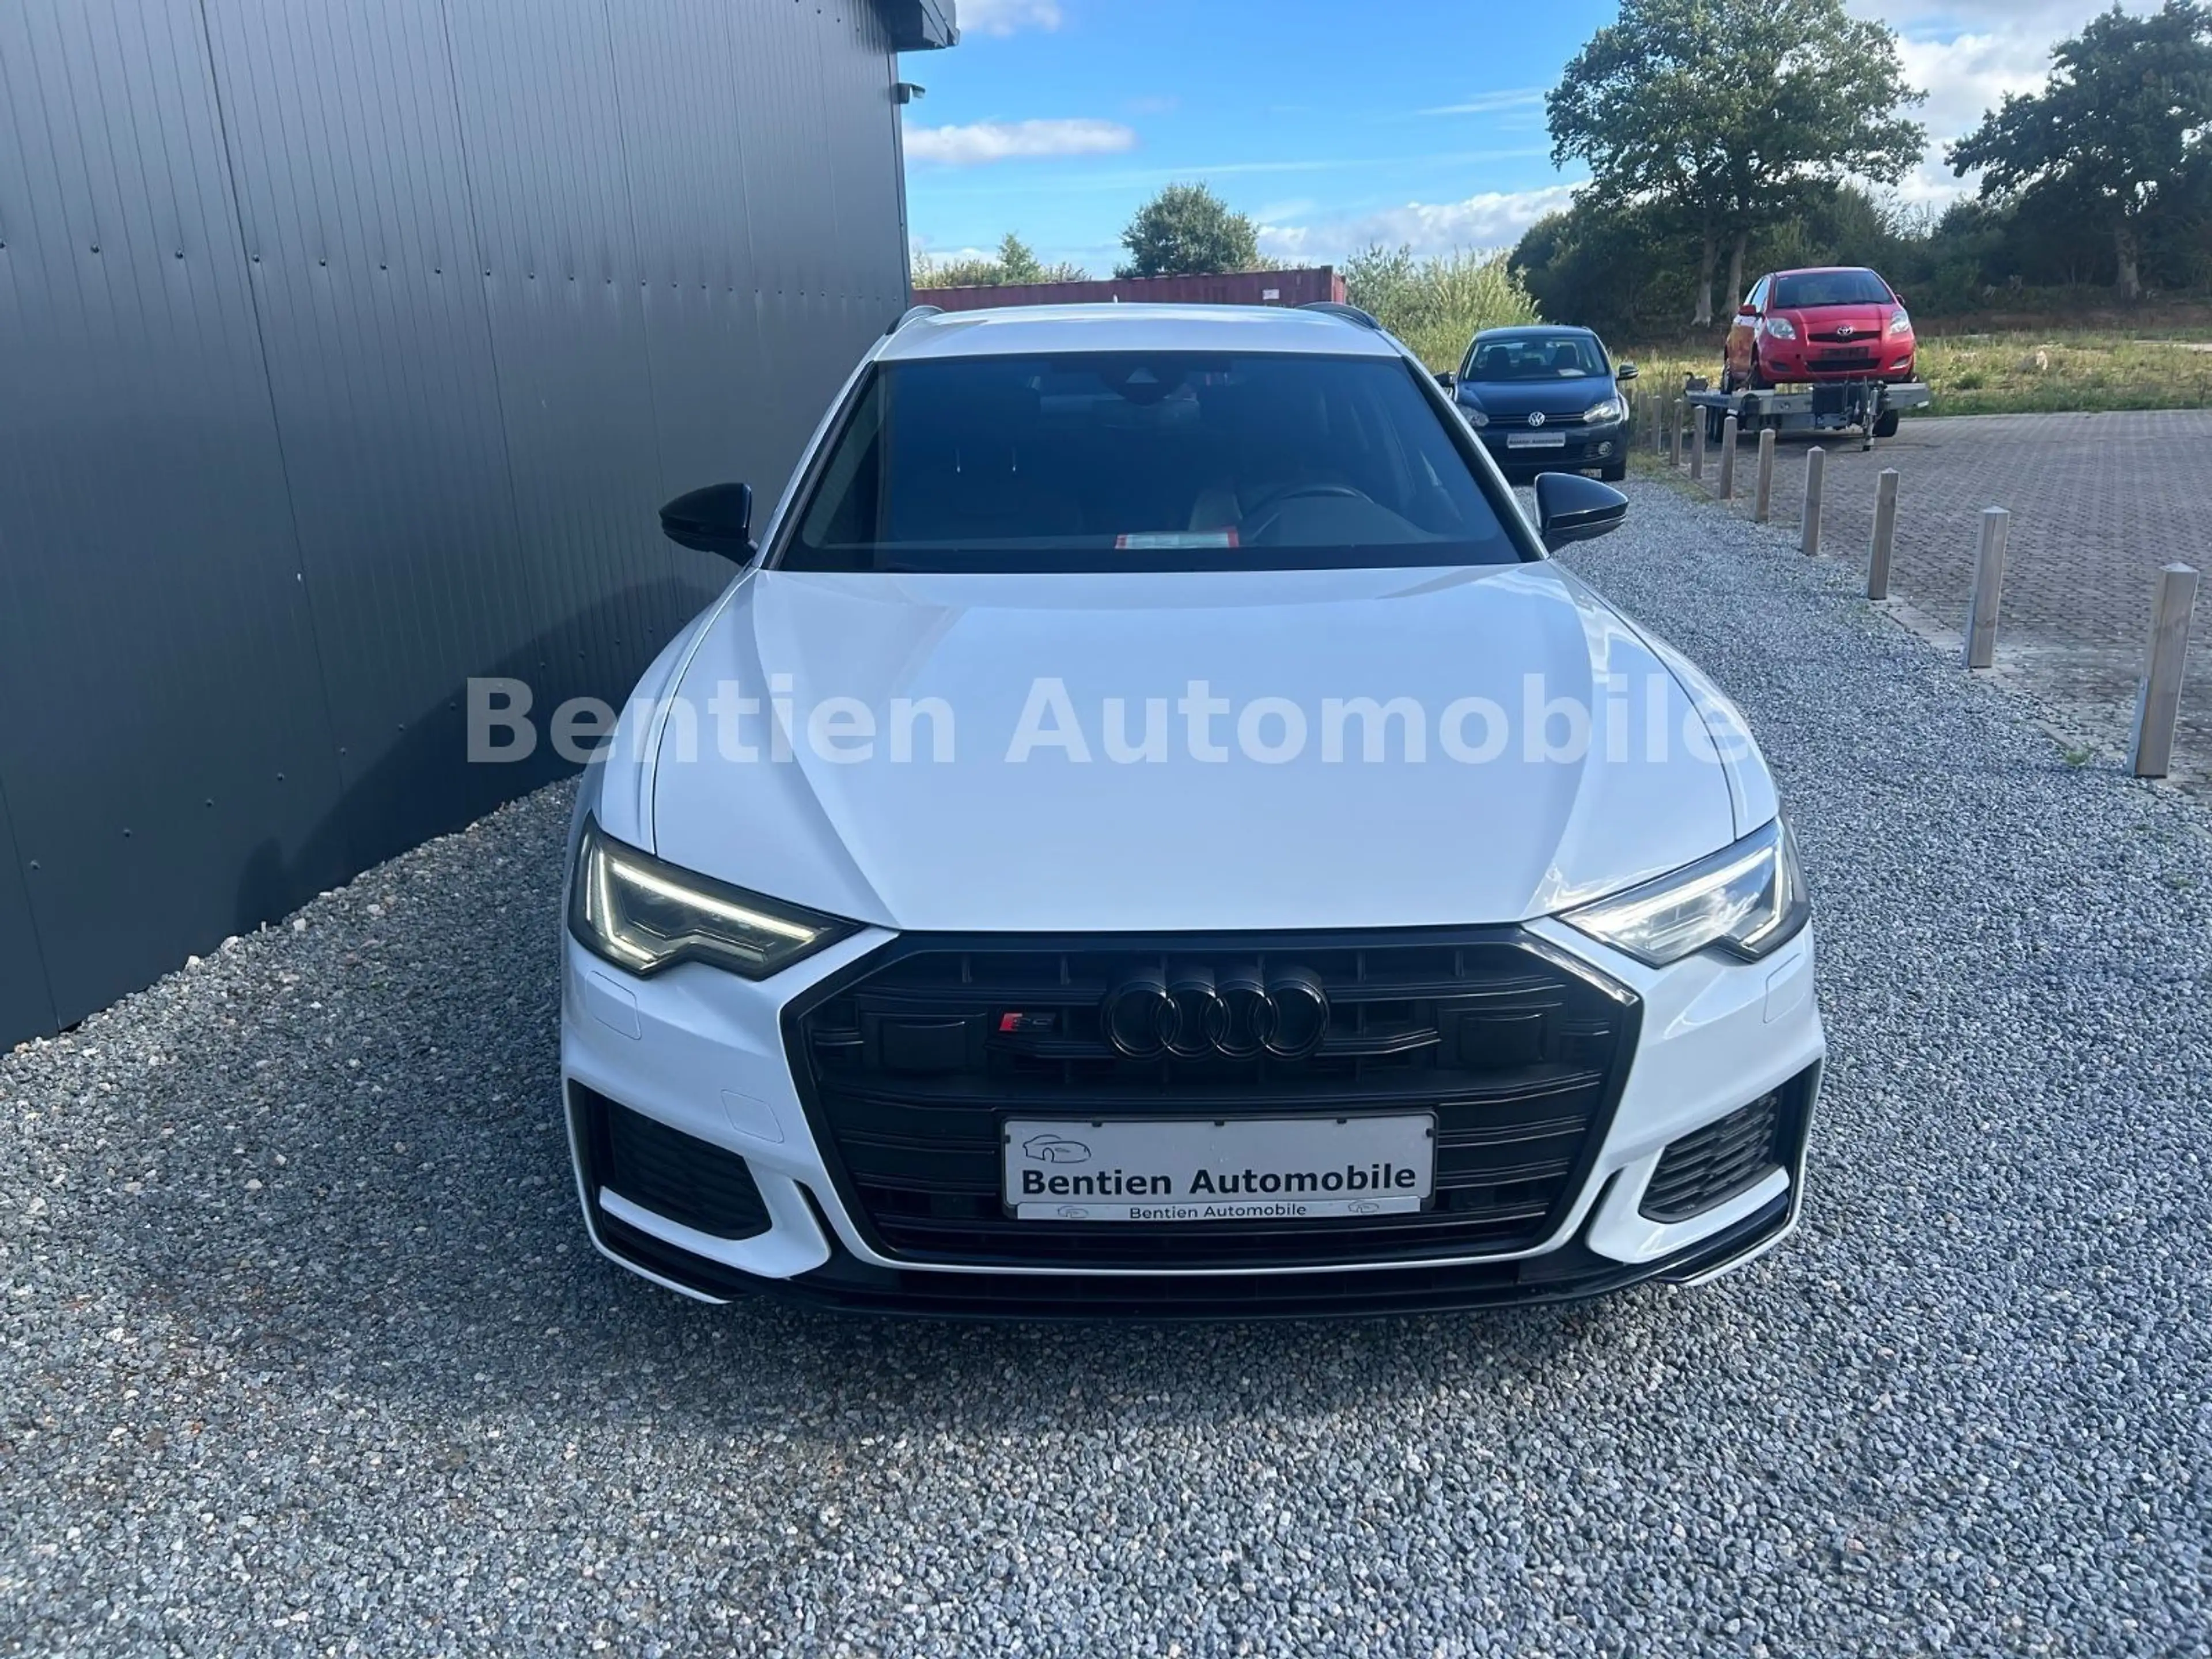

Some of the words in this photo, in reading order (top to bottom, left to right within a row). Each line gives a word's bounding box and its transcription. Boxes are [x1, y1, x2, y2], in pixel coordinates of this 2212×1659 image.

[1022, 1169, 1171, 1195] Bentien
[1189, 1163, 1415, 1194] Automobile
[1130, 1207, 1198, 1219] Bentien
[1204, 1203, 1306, 1217] Automobile
